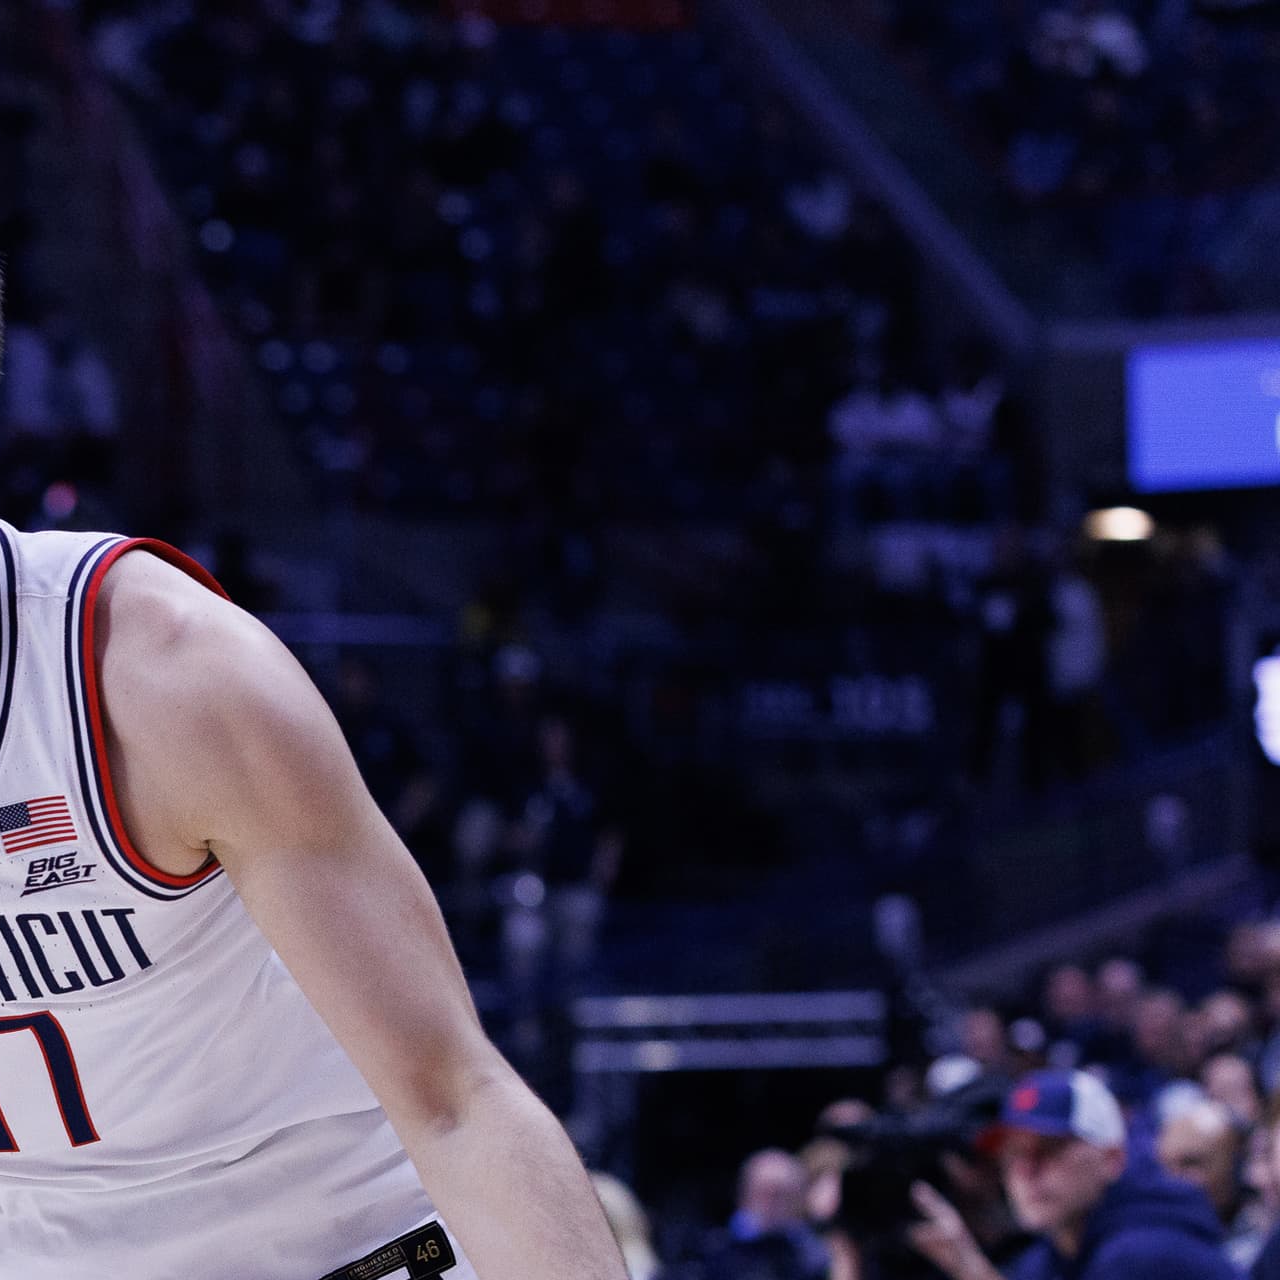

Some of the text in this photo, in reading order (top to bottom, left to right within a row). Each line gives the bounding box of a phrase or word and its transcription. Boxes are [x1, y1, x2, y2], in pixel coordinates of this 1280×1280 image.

[27, 850, 78, 875] BIG
[24, 863, 98, 888] EAST
[416, 1239, 441, 1263] 46
